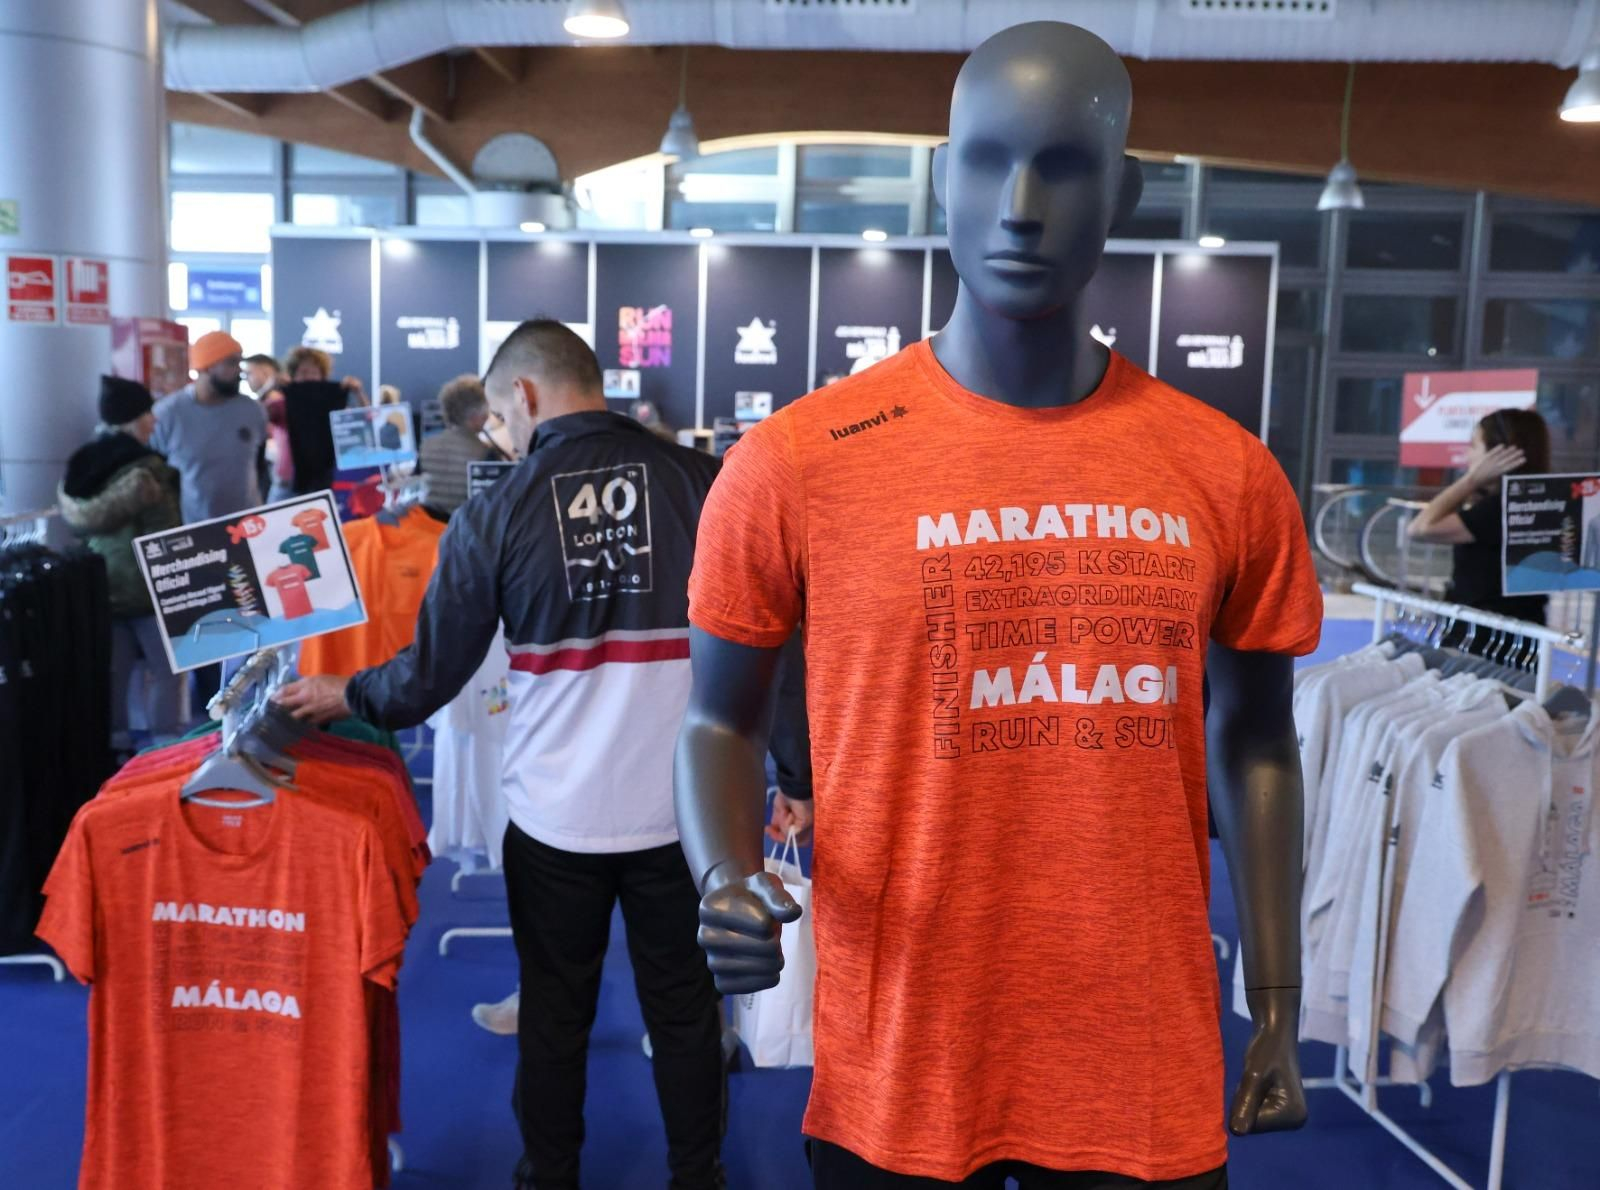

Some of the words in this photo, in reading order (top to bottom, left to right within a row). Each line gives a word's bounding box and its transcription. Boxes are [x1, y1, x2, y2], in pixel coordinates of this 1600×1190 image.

[830, 411, 888, 441] luanvi
[567, 477, 637, 525] 40
[573, 525, 638, 547] LONDON
[916, 504, 1191, 549] MARATHON
[964, 552, 1066, 582] 42,195
[1079, 550, 1102, 575] K
[1108, 549, 1196, 582] START
[966, 584, 1198, 612] EXTRAORDINARY
[966, 618, 1057, 650] TIME
[1070, 616, 1195, 650] POWER
[922, 553, 960, 759] FINISHER
[971, 716, 1060, 753] RUN
[1074, 717, 1104, 750] &
[152, 902, 305, 932] MARATHON
[171, 980, 302, 1018] MÁLAGA
